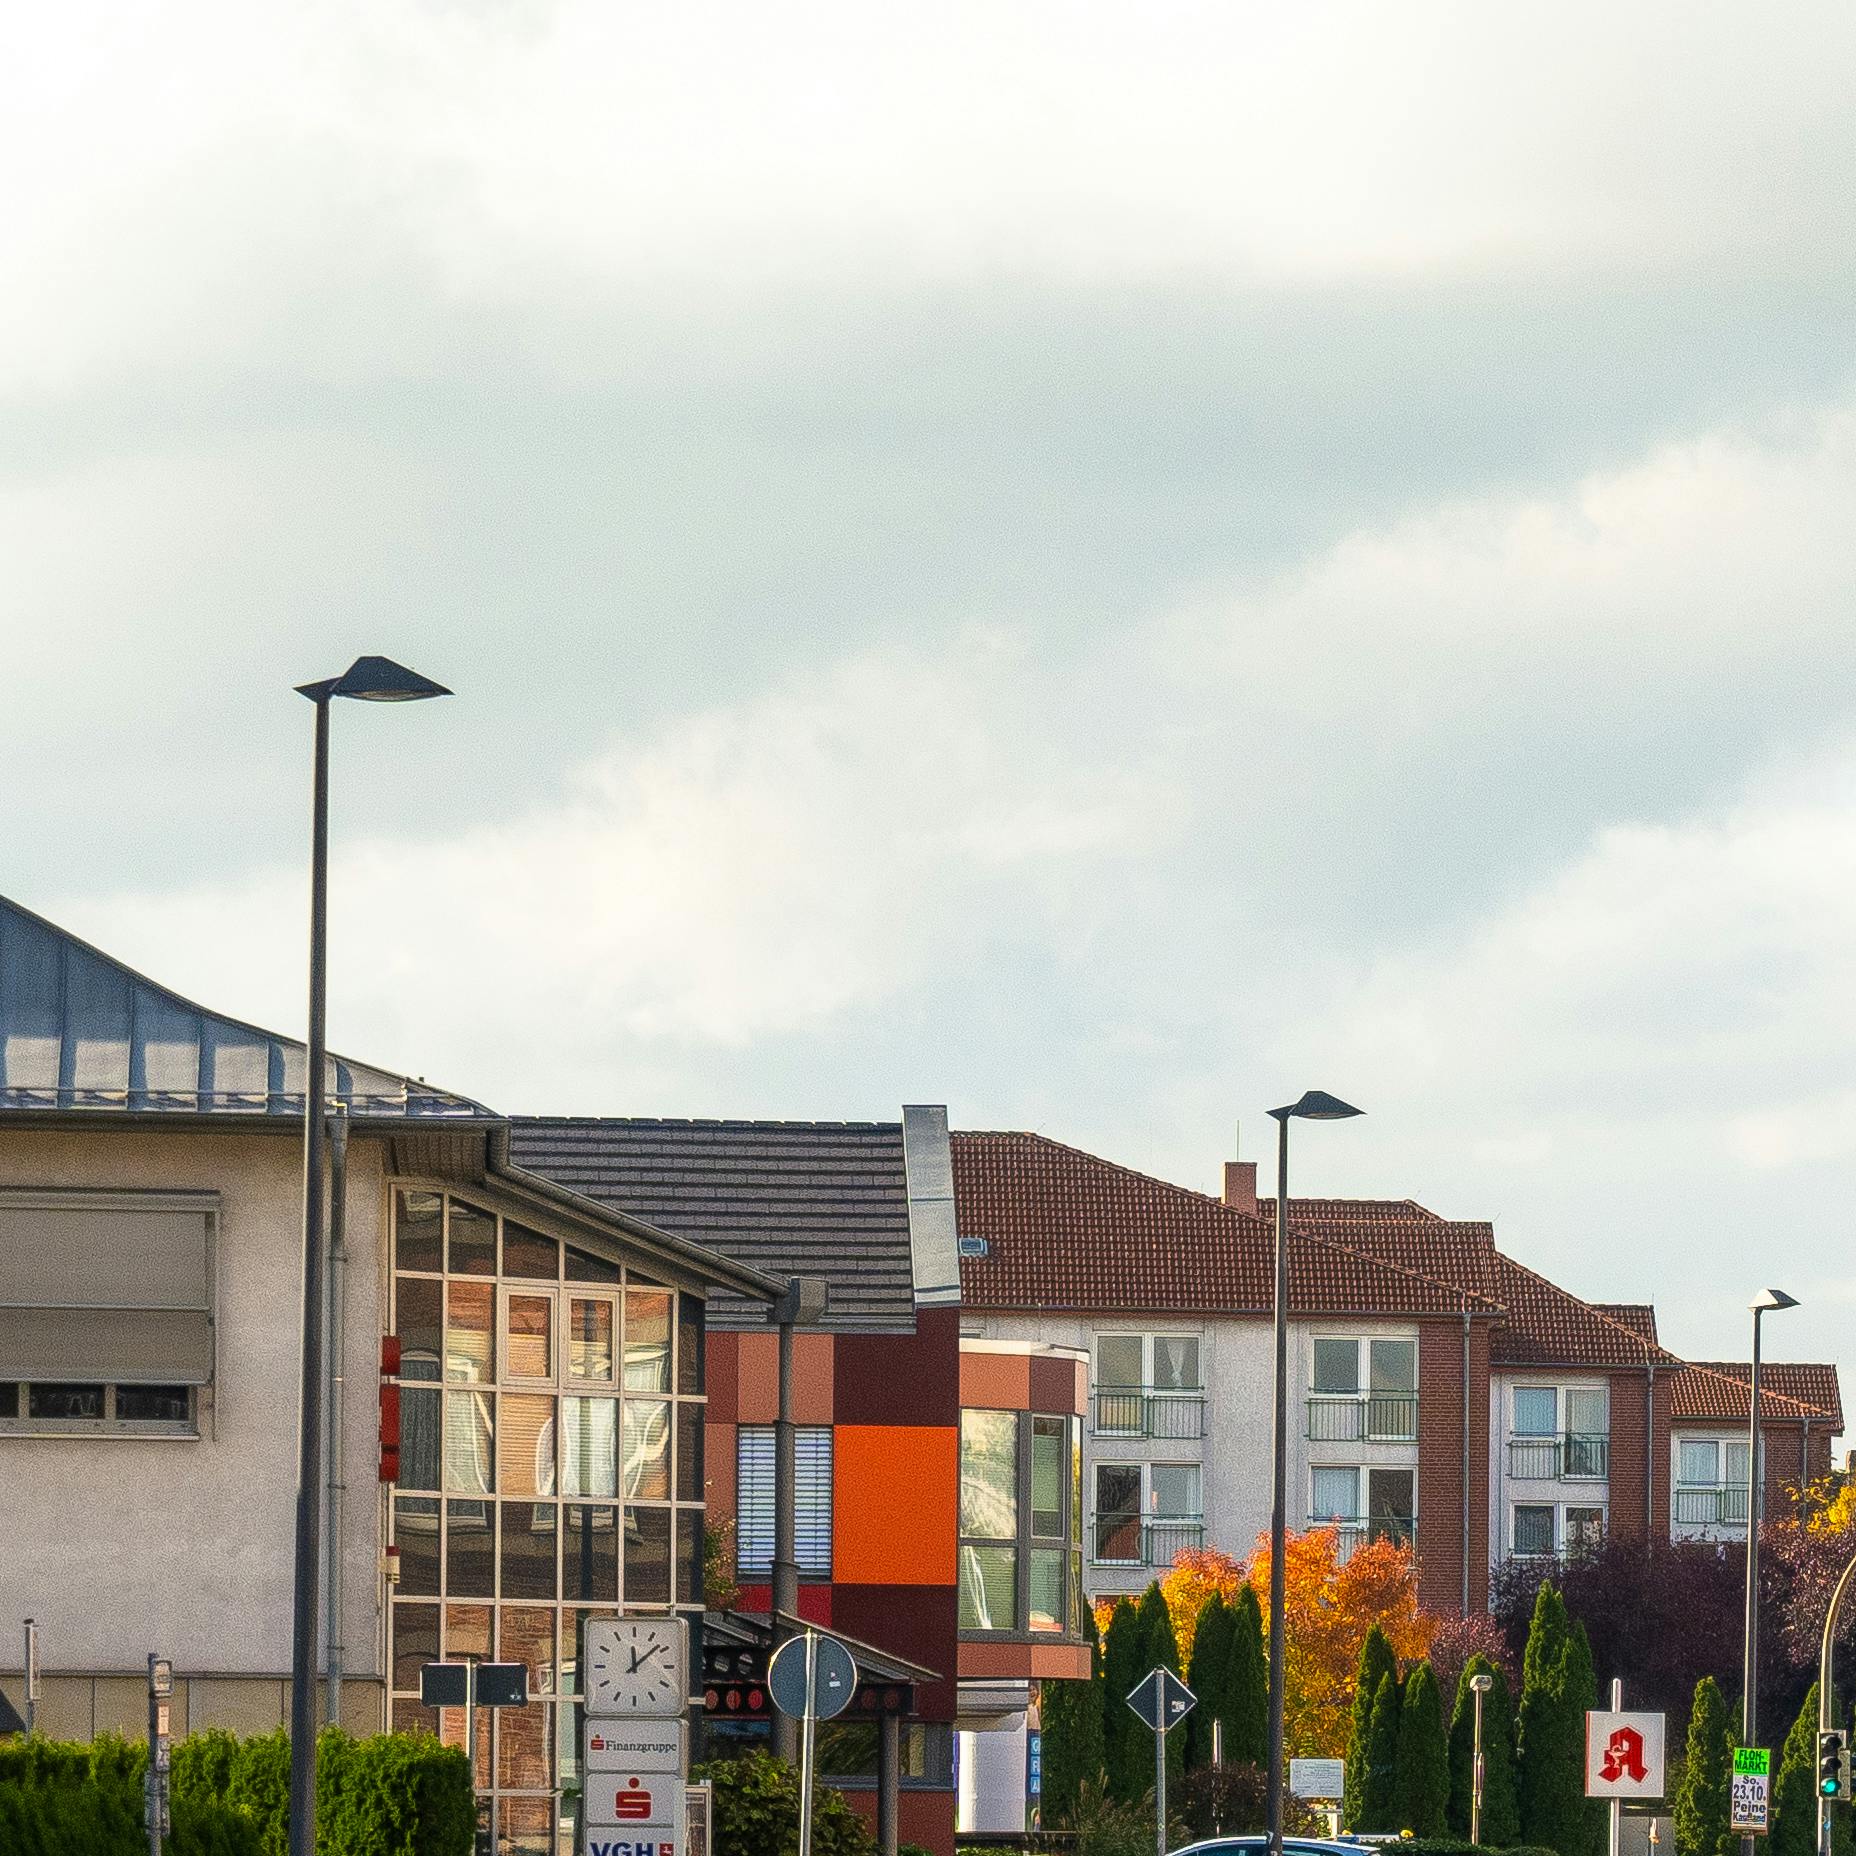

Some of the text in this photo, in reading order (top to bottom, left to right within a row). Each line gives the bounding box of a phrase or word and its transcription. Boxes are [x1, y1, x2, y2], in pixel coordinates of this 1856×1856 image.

[606, 1740, 678, 1755] Finanzgruppe
[1739, 1750, 1765, 1761] FLOH-
[1735, 1760, 1768, 1772] MARKT
[1742, 1775, 1760, 1785] So.
[1733, 1784, 1767, 1801] 23.10.
[1734, 1801, 1766, 1813] Peine
